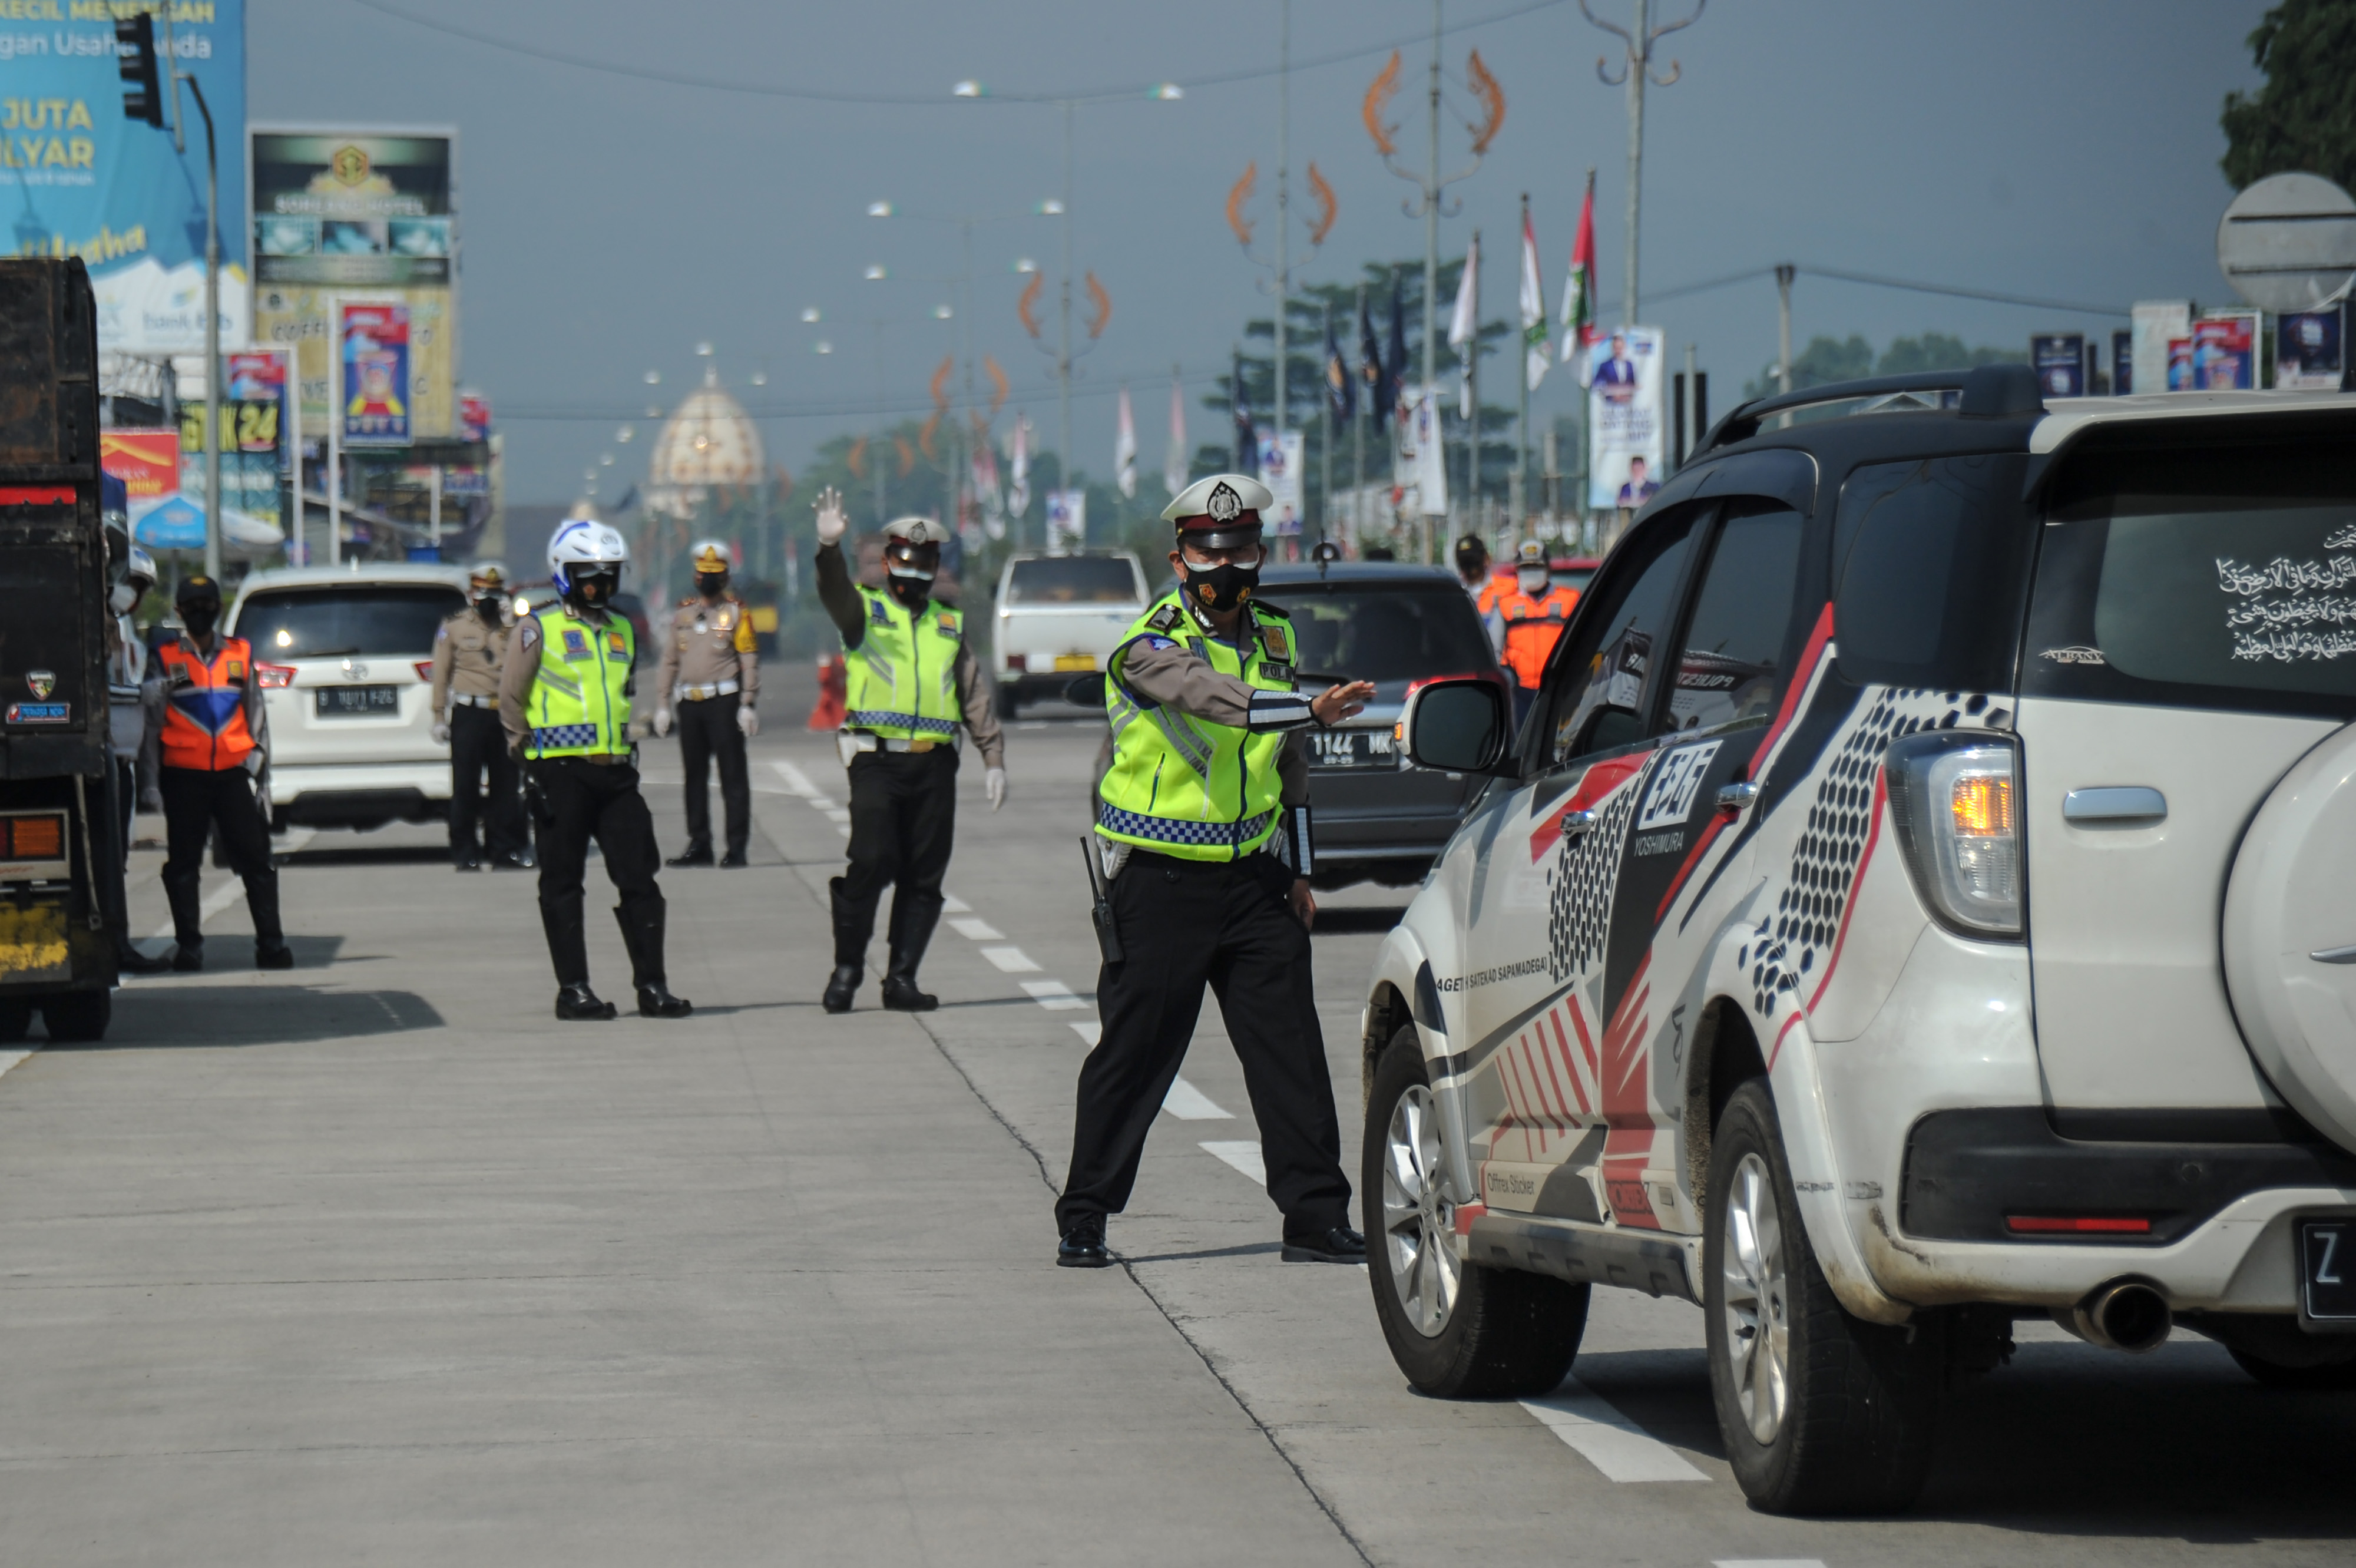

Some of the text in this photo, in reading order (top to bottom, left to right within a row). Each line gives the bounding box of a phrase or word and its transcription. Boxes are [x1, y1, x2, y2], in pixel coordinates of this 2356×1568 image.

[3, 97, 93, 131] JUTA
[2044, 650, 2103, 660] ALBANY
[1634, 831, 1685, 857] YOSHIMURA
[2314, 1232, 2341, 1283] Z
